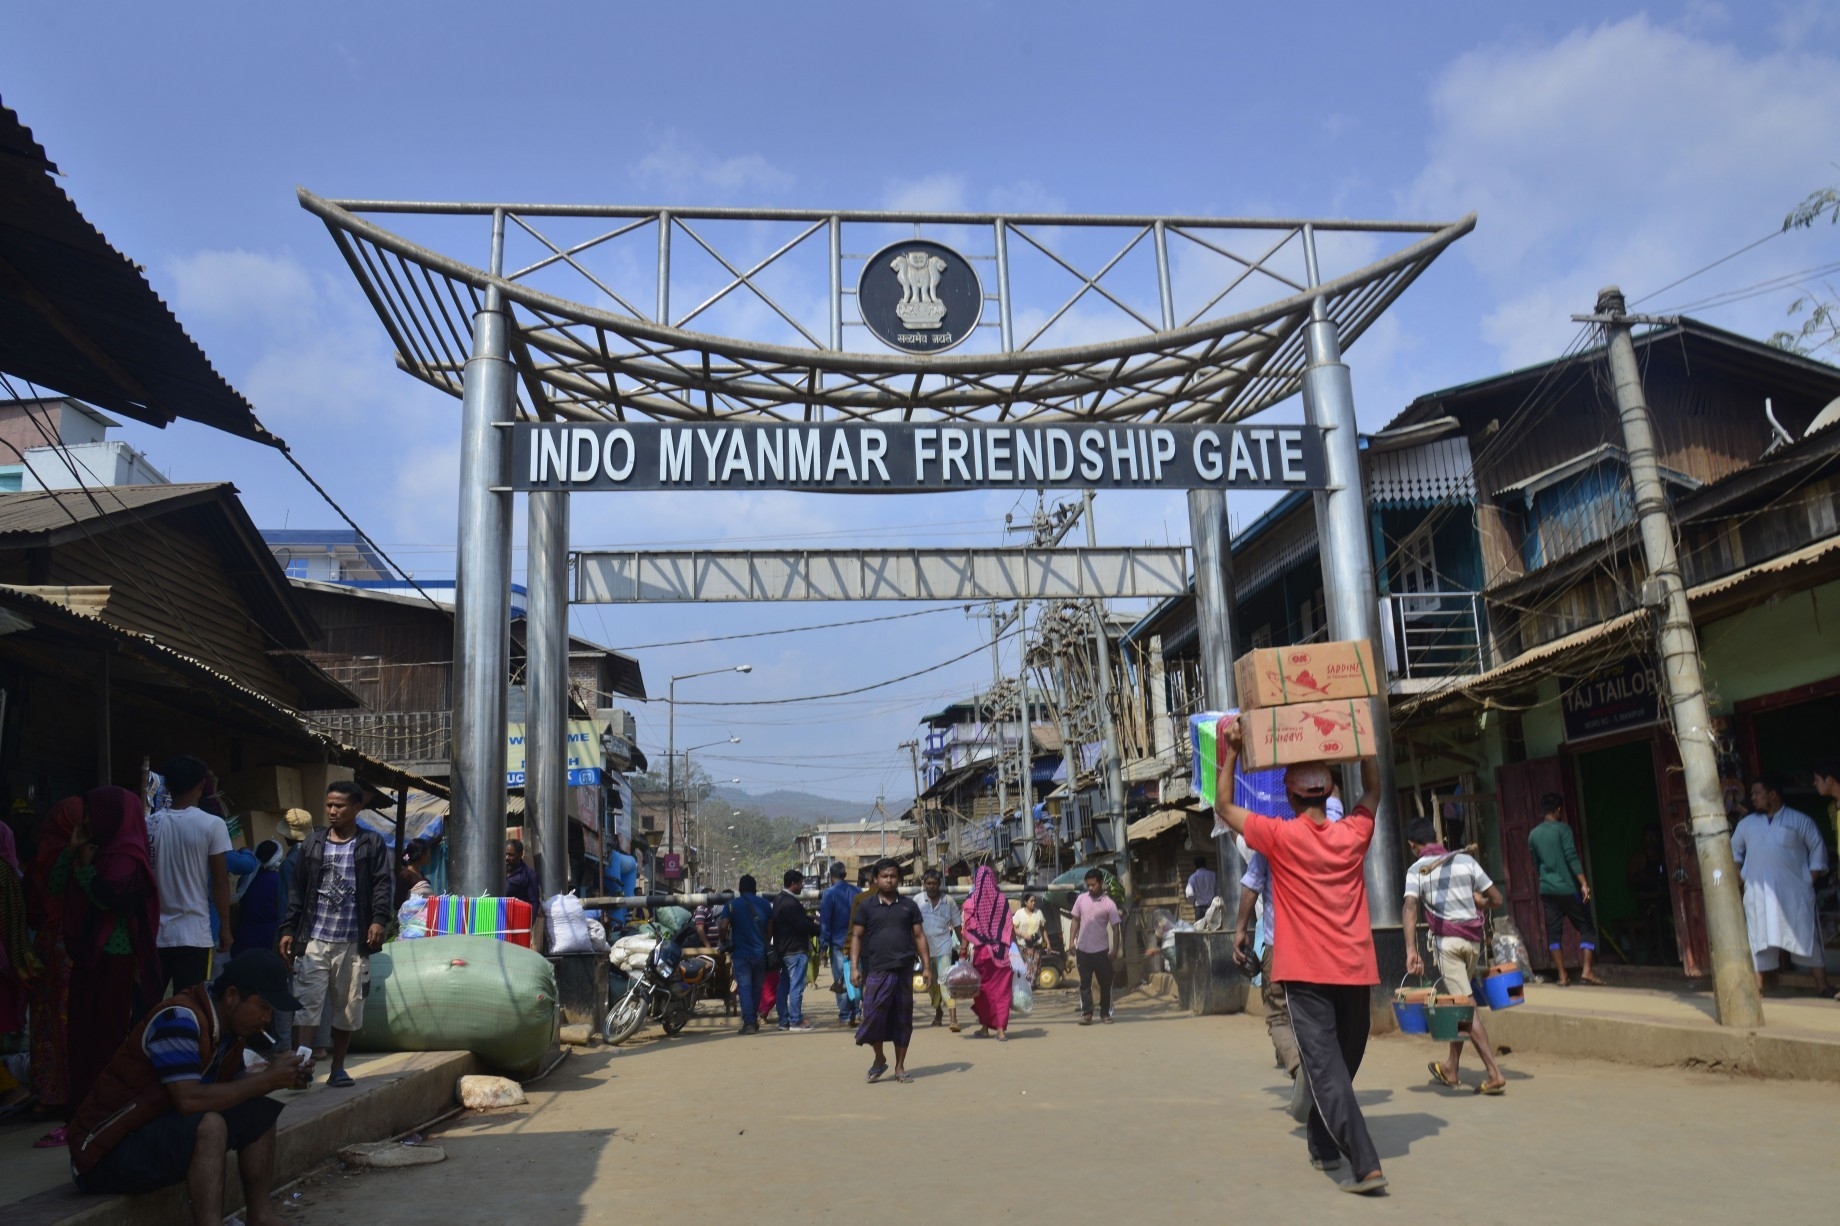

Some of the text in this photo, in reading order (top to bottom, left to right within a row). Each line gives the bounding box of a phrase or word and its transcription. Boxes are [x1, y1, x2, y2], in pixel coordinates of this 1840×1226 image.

[529, 428, 1306, 482] INDO MYANMAR FRIENDSHIP GATE
[1327, 662, 1361, 674] SARDINE
[1565, 686, 1592, 712] TAJ
[1596, 668, 1658, 704] TAILOR
